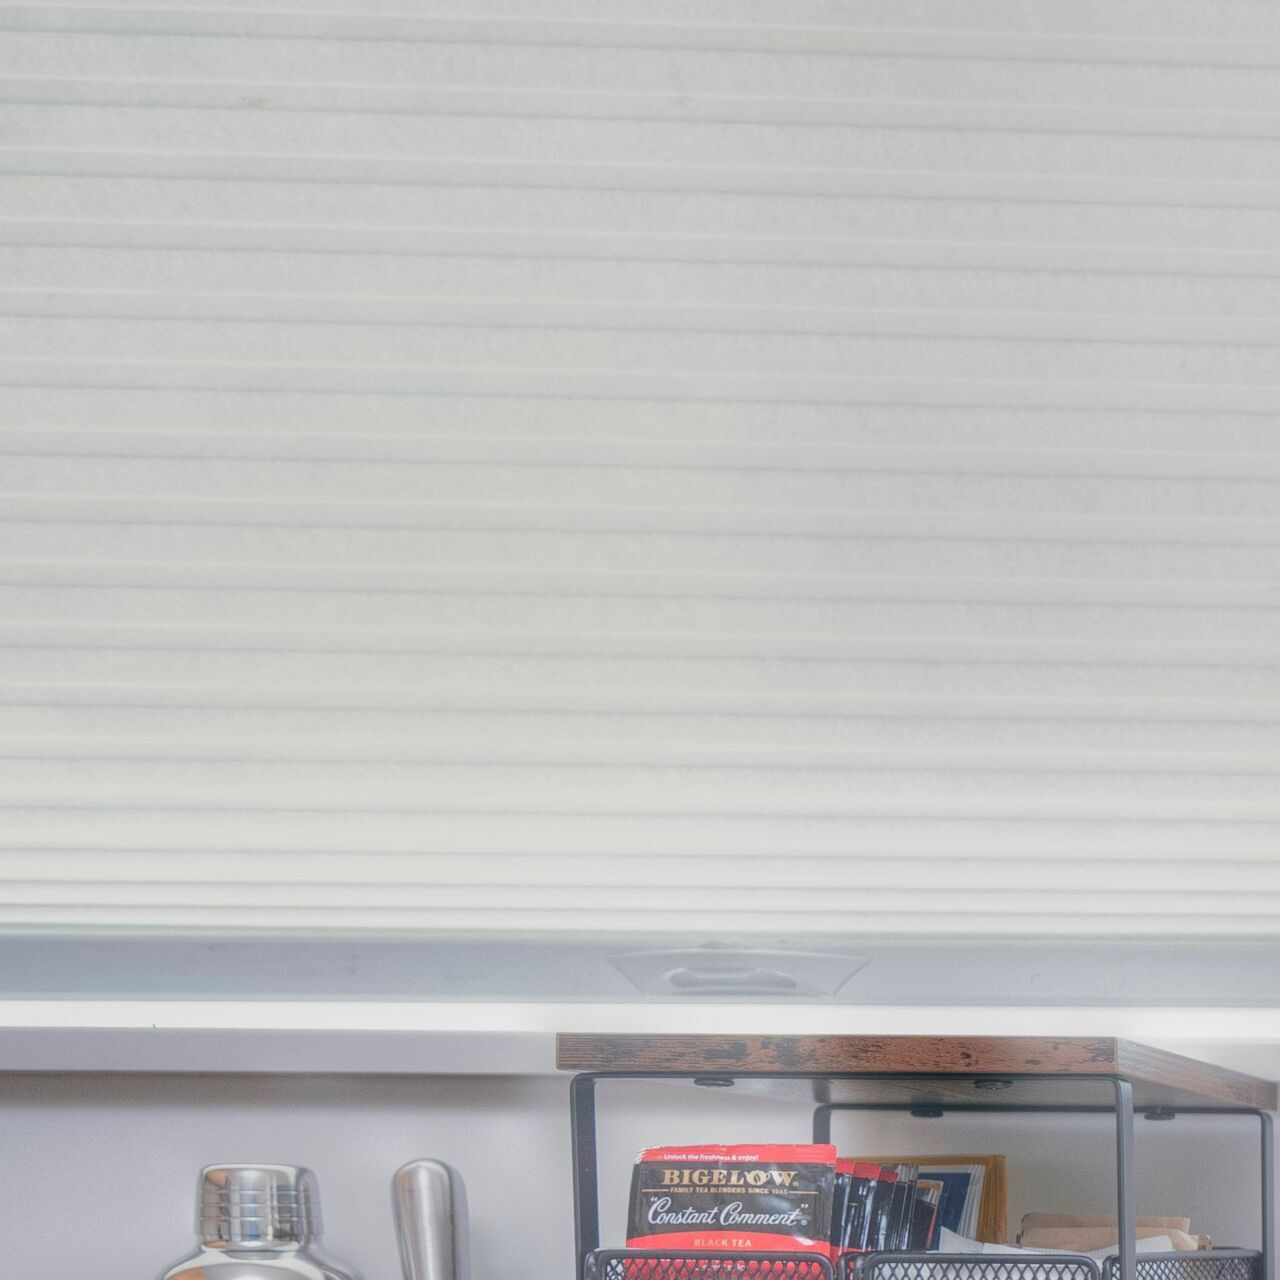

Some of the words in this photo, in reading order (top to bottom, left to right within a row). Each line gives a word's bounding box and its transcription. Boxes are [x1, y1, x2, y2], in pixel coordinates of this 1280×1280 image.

[663, 1153, 687, 1161] Unlock
[700, 1154, 731, 1162] freshness
[738, 1155, 759, 1163] enjoy!
[661, 1168, 799, 1187] BIGELOW
[694, 1238, 728, 1247] BLACK
[731, 1239, 752, 1248] TEA
